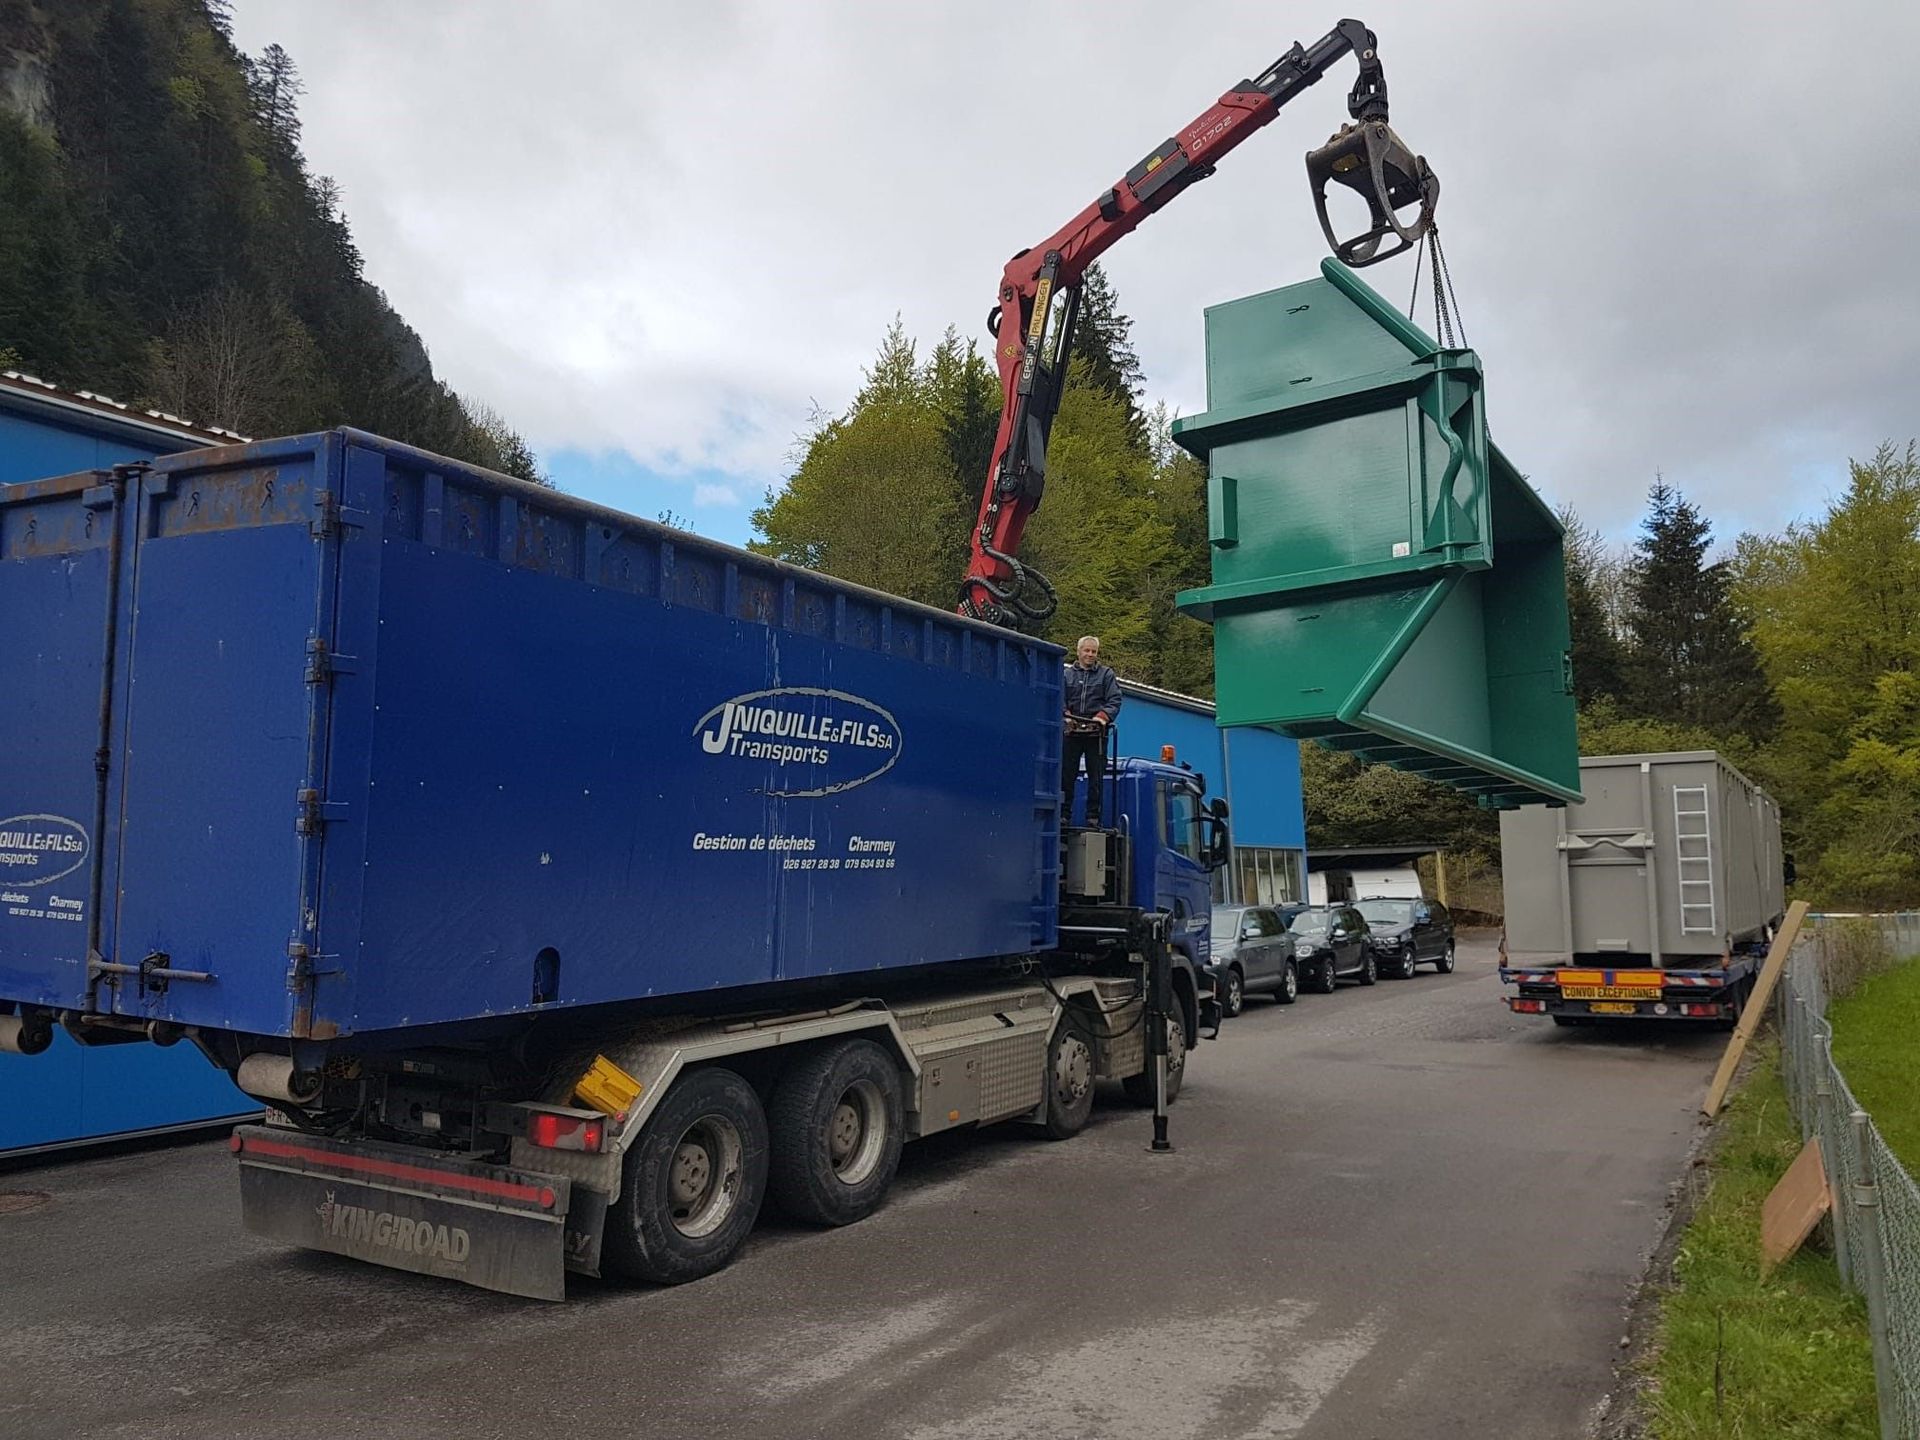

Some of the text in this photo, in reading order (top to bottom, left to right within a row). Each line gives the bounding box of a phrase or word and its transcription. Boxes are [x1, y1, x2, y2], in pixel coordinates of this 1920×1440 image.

[1023, 281, 1050, 379] EPSIN PALFINGER
[730, 733, 829, 766] Transports
[693, 832, 896, 855] Gestion de déchets Charmey
[49, 895, 84, 912] Charmey
[1564, 986, 1659, 999] CONVOI EXCEPTIONNEL
[331, 1203, 392, 1247] KING
[394, 1217, 470, 1262] ROAD
